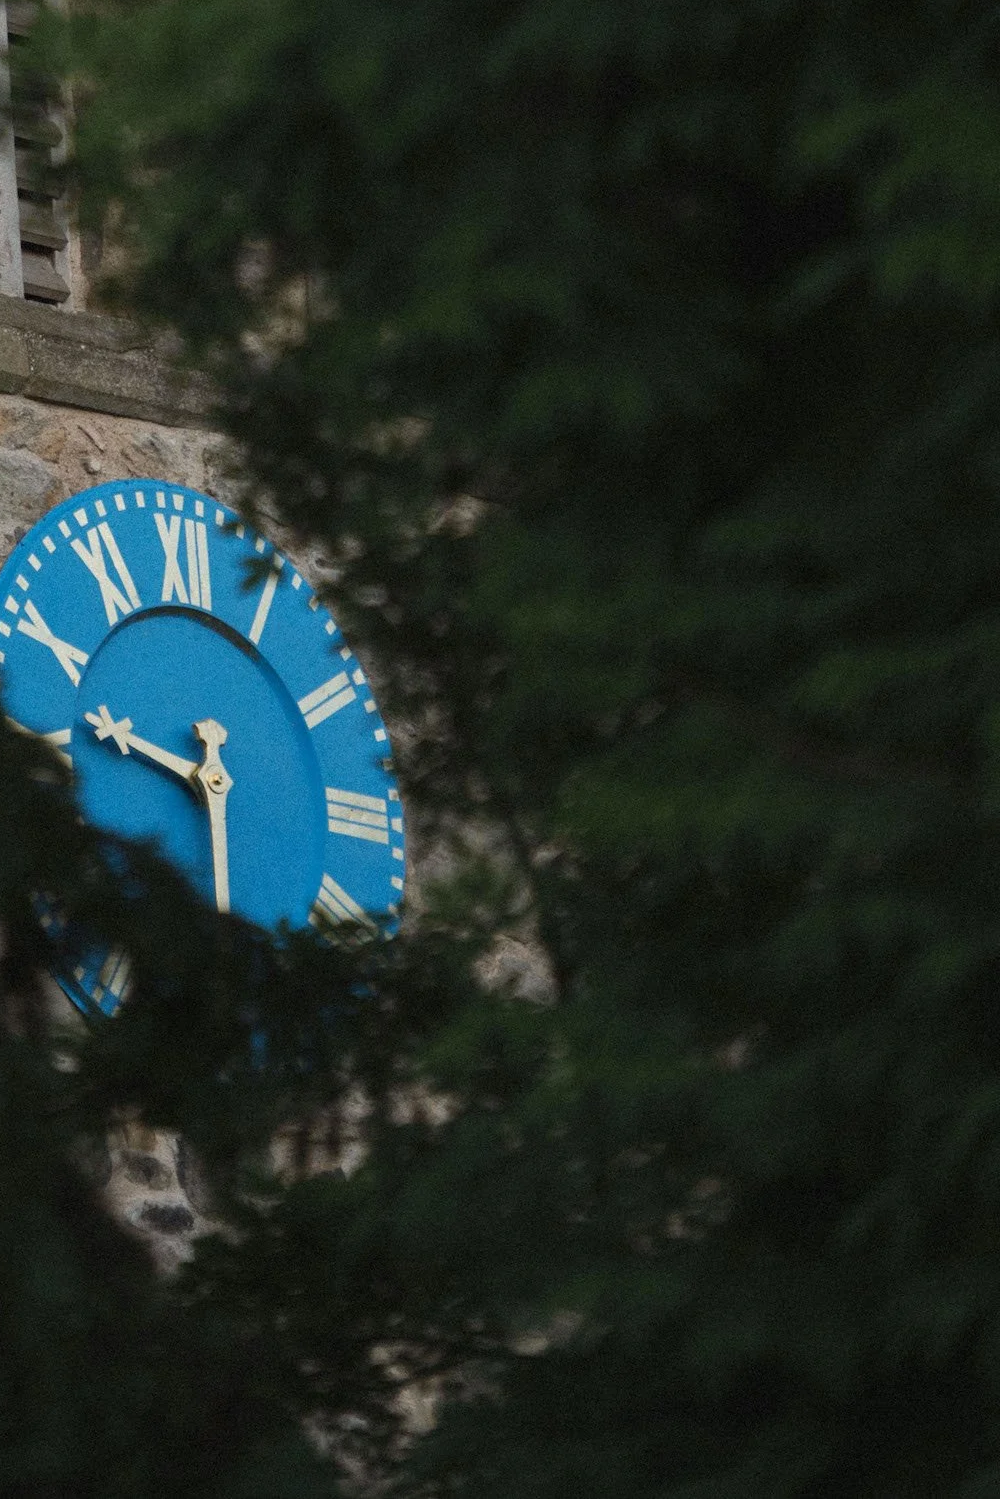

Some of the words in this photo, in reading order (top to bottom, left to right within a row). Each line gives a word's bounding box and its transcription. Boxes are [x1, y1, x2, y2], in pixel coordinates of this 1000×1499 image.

[71, 522, 141, 626] XI
[153, 513, 212, 612] XII
[17, 600, 90, 688] X
[249, 573, 279, 643] I
[298, 671, 357, 729] II
[325, 787, 390, 844] III
